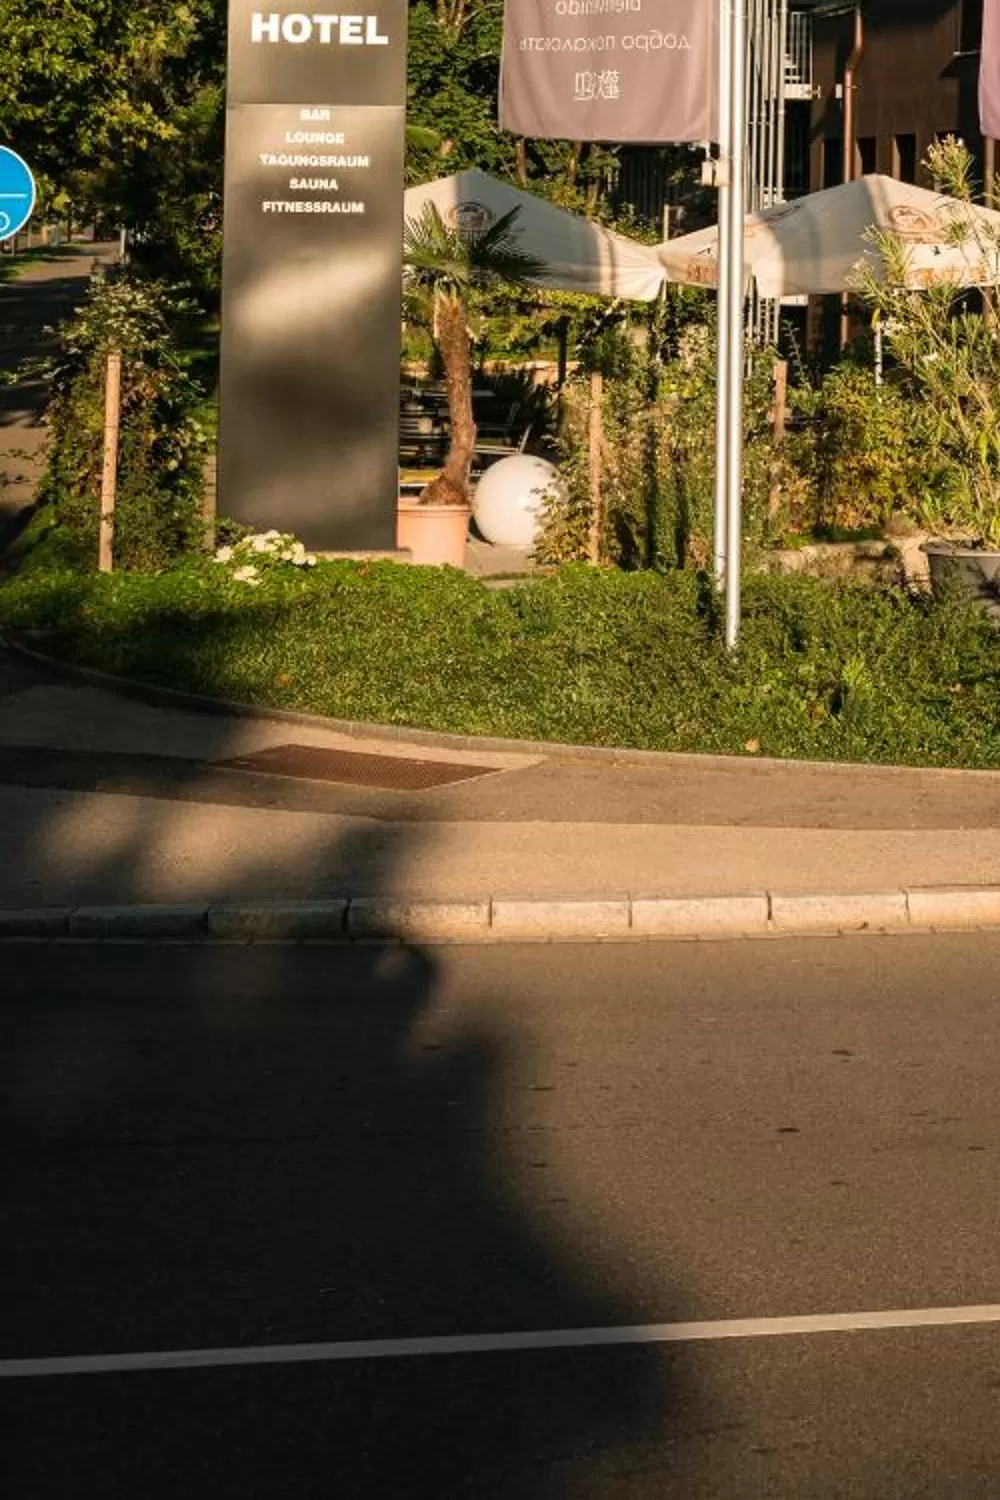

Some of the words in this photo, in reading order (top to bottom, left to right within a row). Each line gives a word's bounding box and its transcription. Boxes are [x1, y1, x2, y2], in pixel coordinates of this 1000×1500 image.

[252, 12, 388, 44] HOTEL
[300, 108, 331, 121] BAR
[285, 132, 344, 145] LOUNGE
[260, 153, 369, 167] TAGUNGSRAUM
[289, 178, 338, 190] SAUNA
[262, 201, 364, 213] FITNESSRAUM
